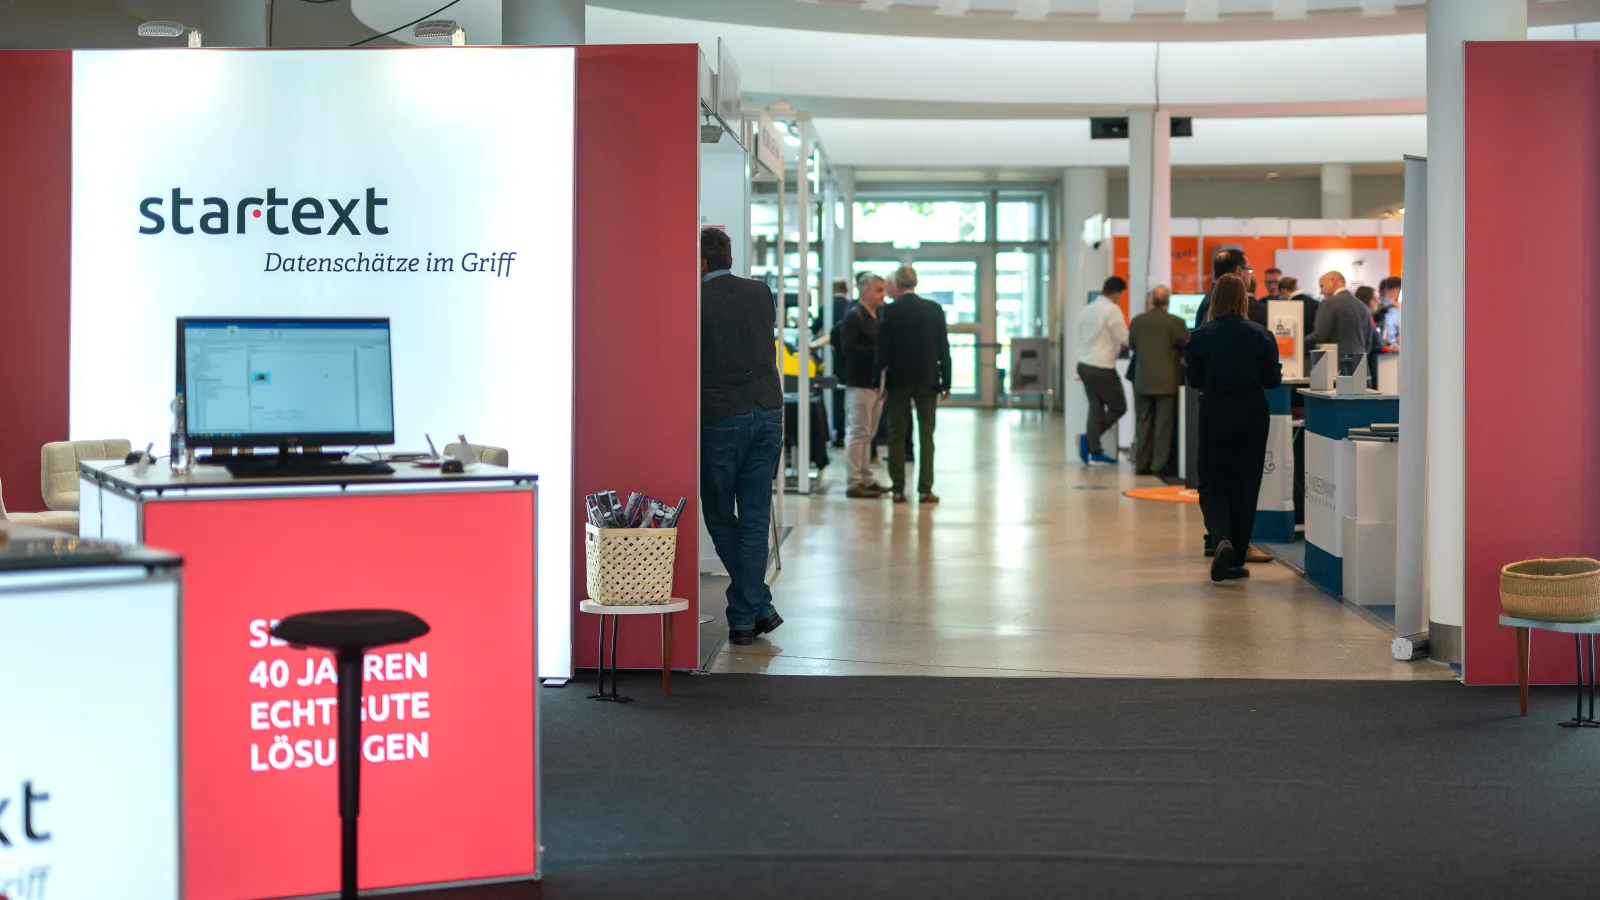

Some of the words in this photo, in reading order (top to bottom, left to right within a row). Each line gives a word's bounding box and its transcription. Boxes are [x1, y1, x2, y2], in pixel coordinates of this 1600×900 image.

[139, 187, 389, 236] startext
[263, 252, 420, 273] Datenschätze
[426, 252, 455, 273] im
[461, 252, 518, 278] Griff
[249, 659, 290, 689] 40
[296, 652, 428, 687] JAREN
[250, 697, 338, 731] ECHT
[360, 691, 430, 722] UTE
[250, 731, 429, 772] LÖSUGEN
